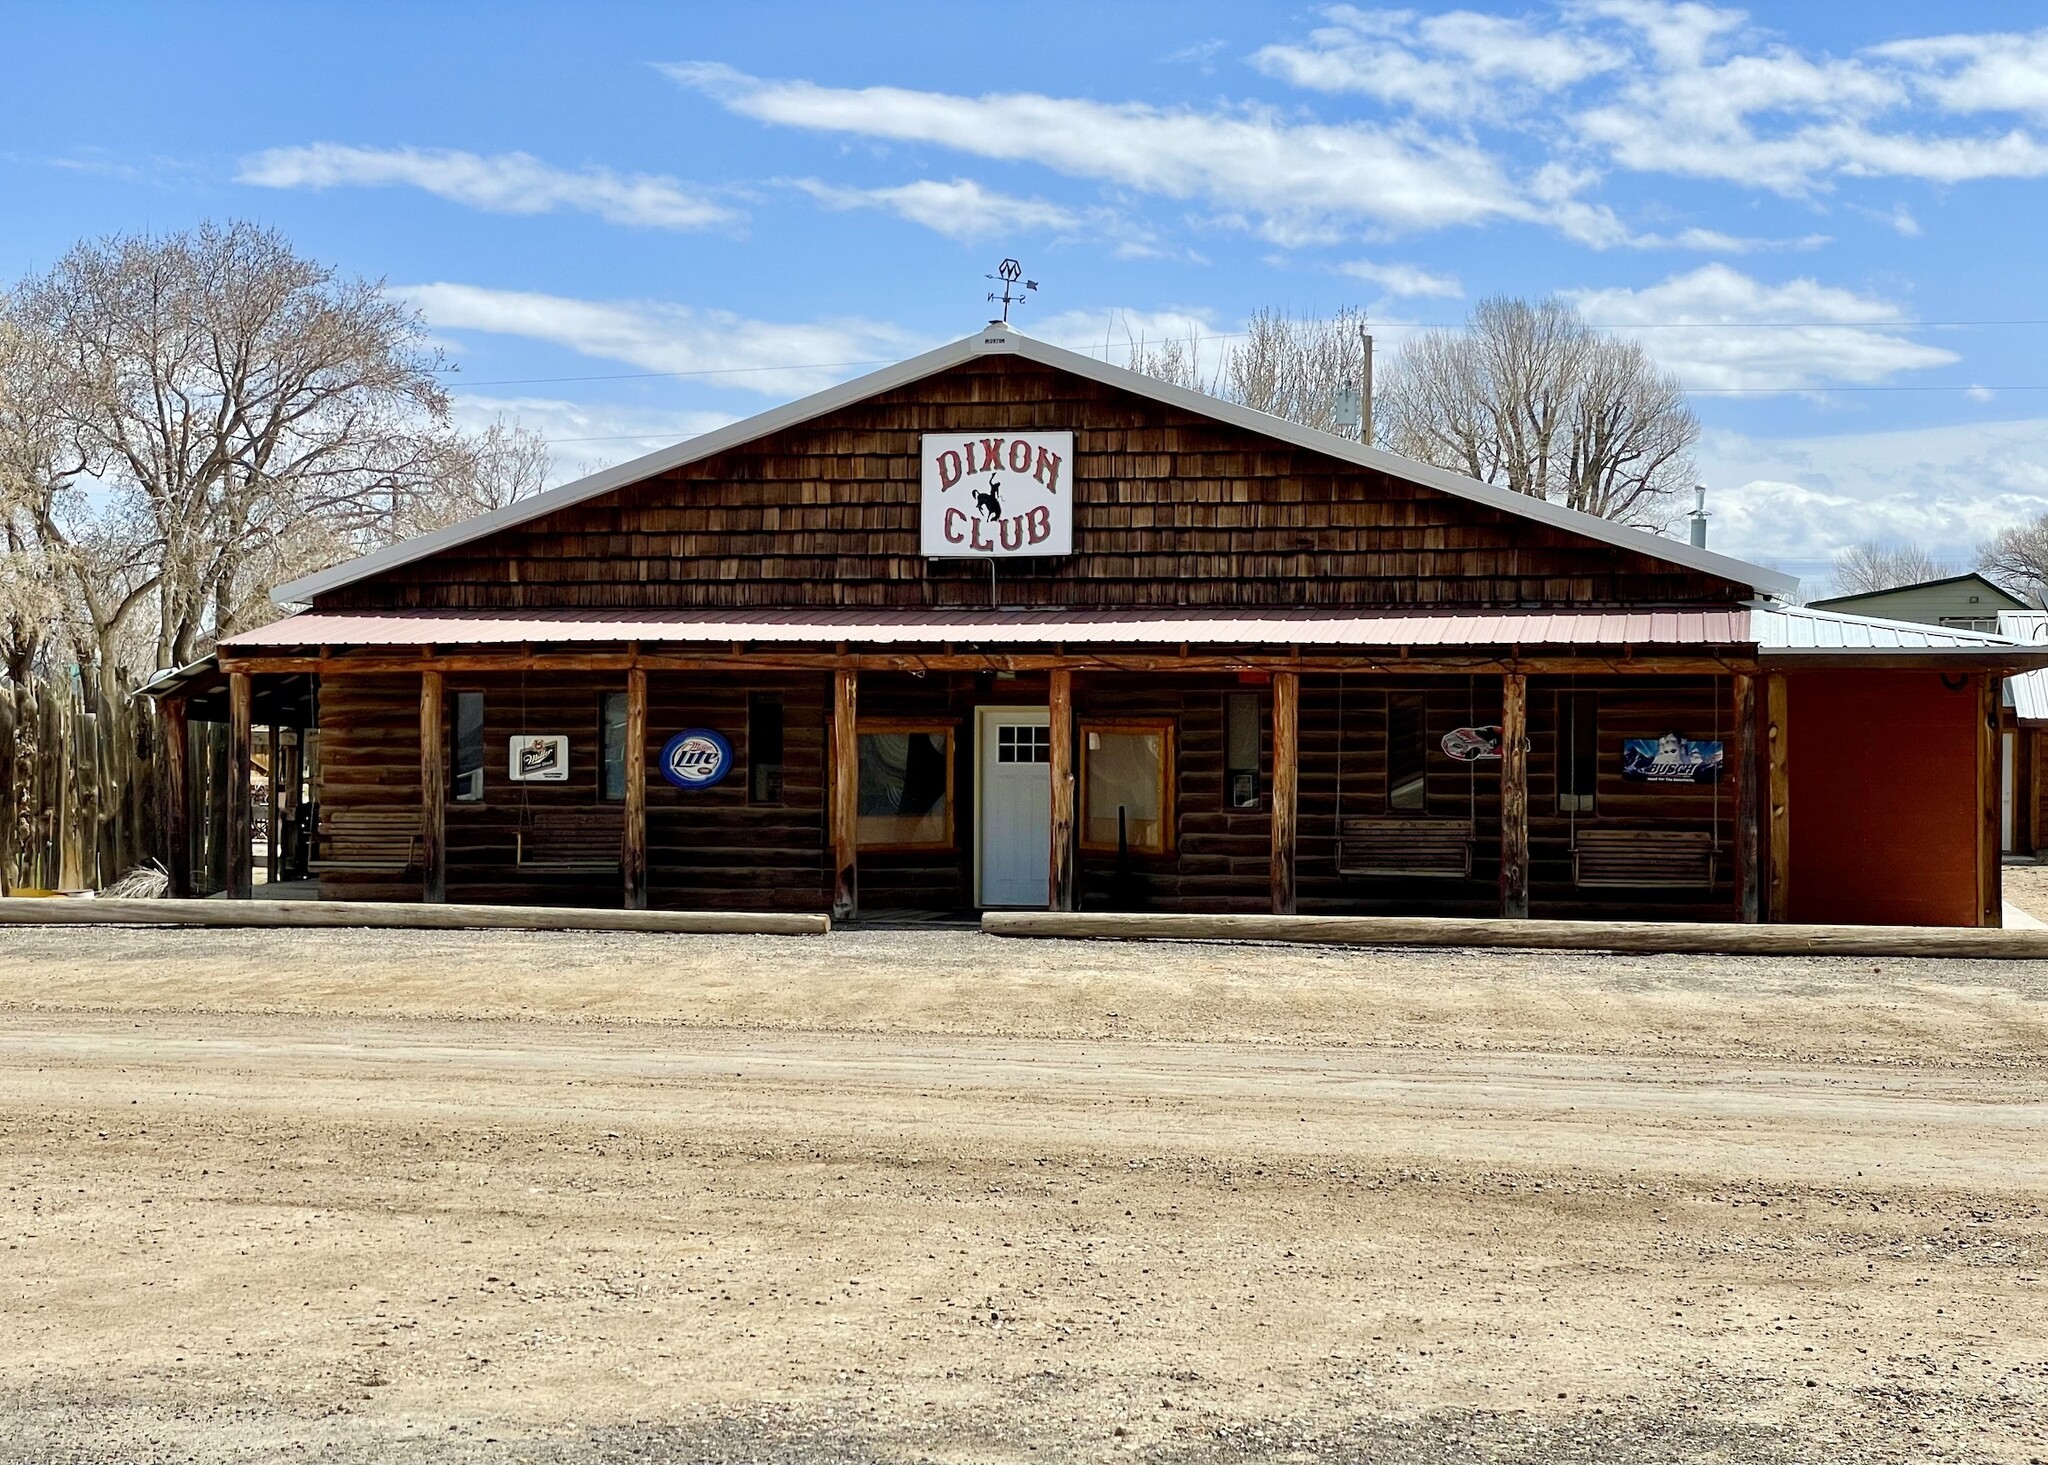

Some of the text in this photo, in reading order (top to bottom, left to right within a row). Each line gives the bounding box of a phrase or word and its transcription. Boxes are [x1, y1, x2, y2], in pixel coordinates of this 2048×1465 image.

[936, 438, 1062, 494] DIXON
[944, 505, 1051, 552] CLUB
[523, 749, 553, 765] Miller
[674, 750, 719, 767] Lite
[1648, 763, 1698, 775] BUSCH
